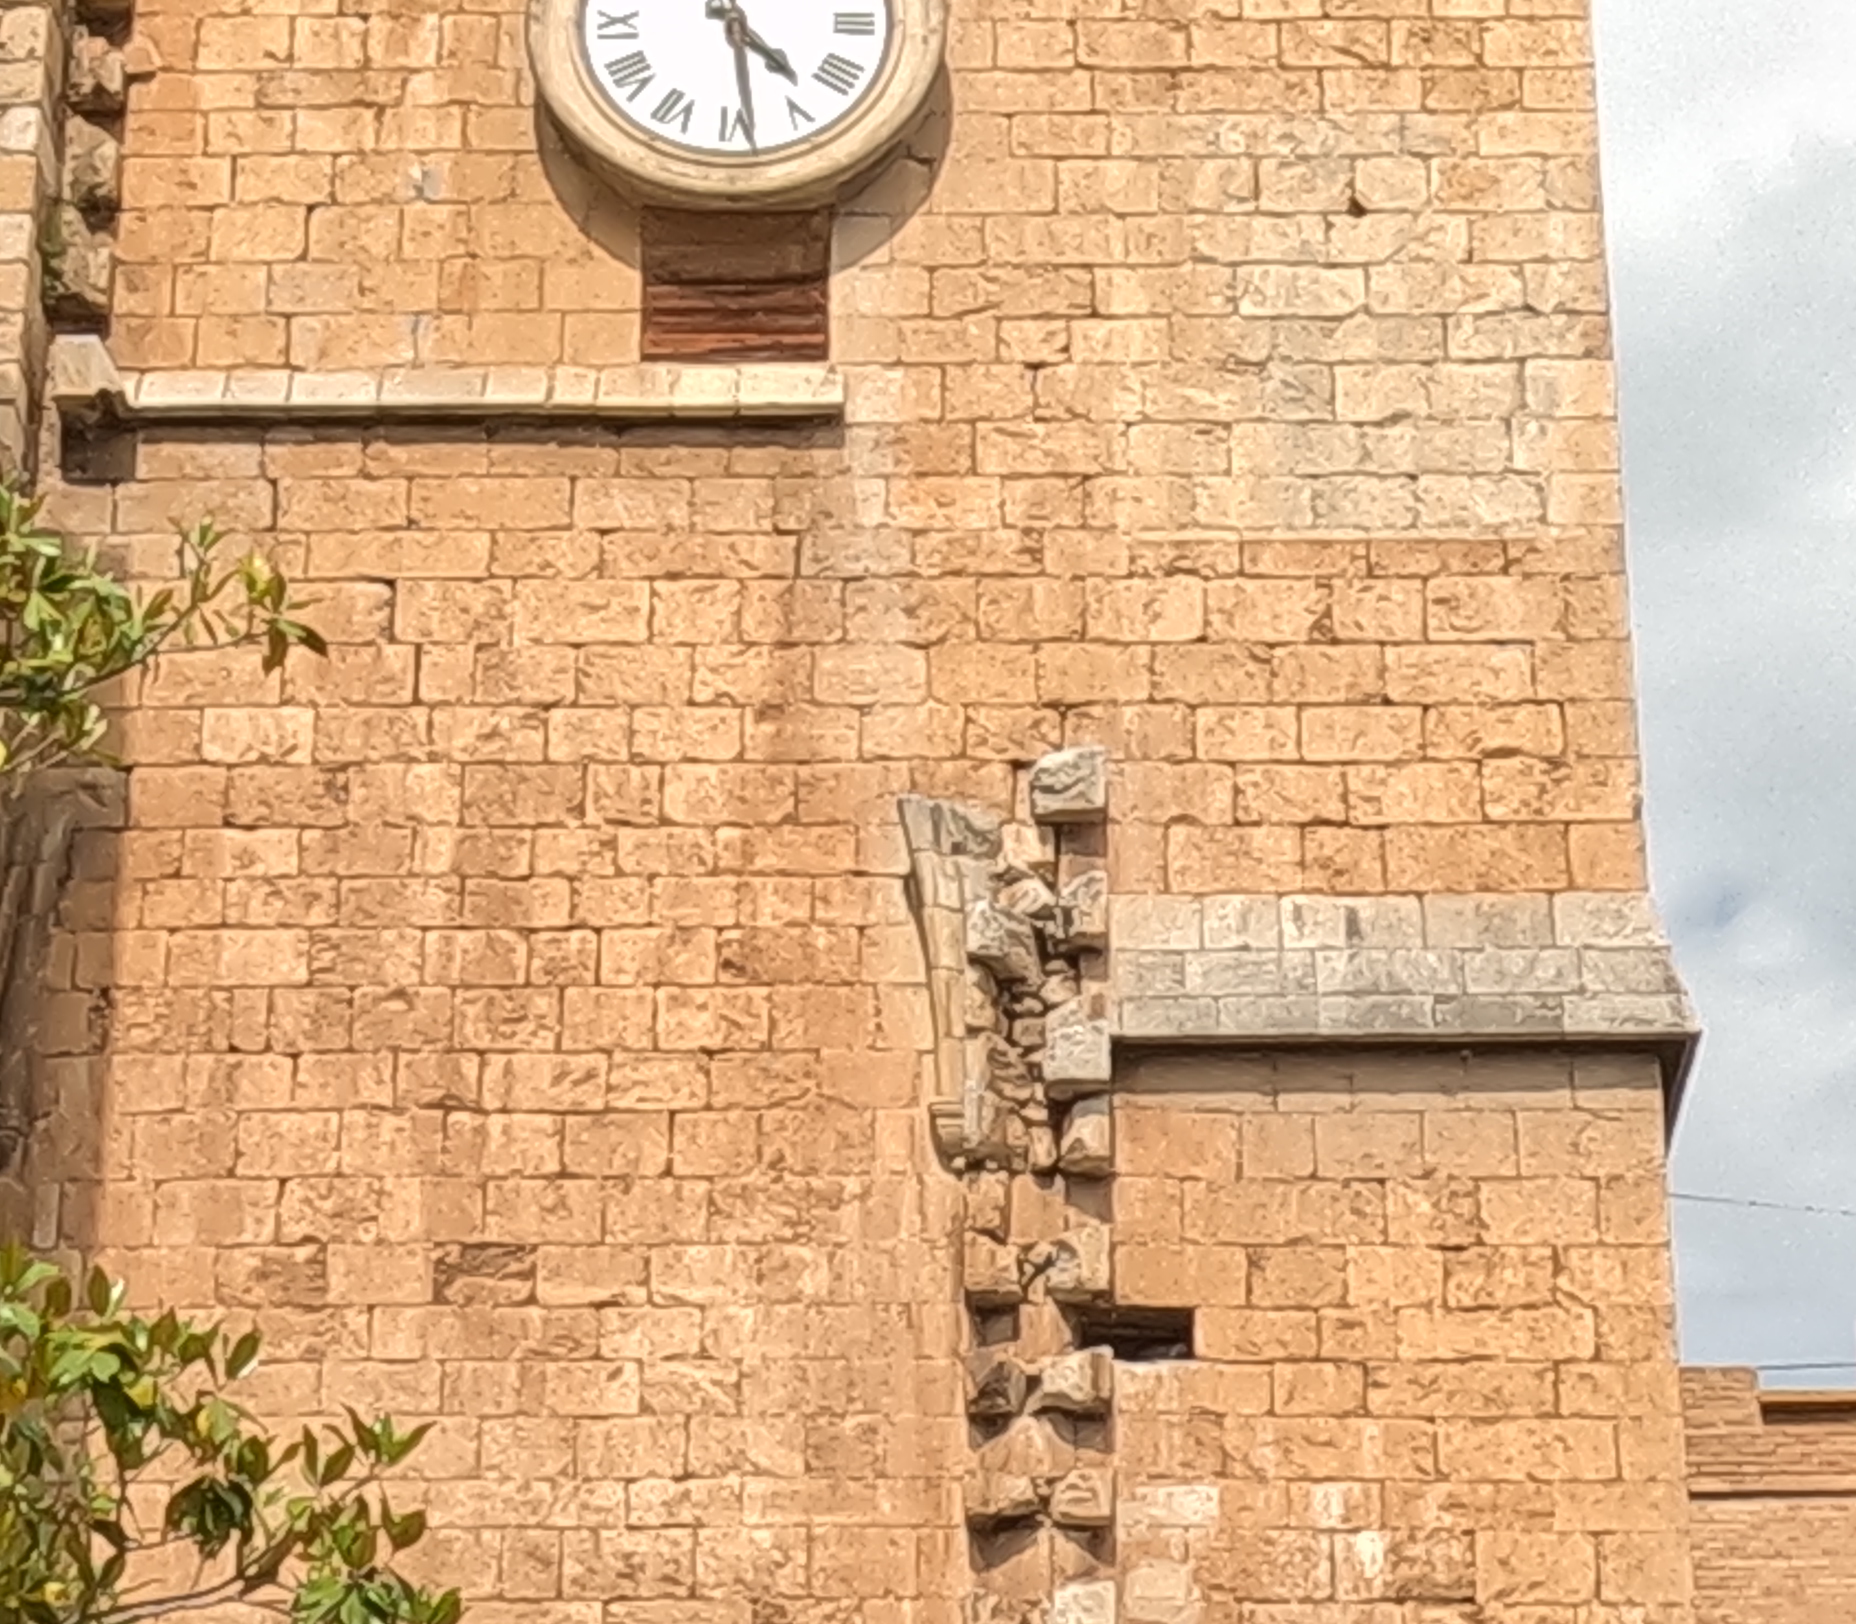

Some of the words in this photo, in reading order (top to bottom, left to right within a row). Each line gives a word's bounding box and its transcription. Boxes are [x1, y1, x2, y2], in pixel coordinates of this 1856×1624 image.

[596, 10, 639, 40] IX
[832, 12, 875, 36] III
[603, 50, 656, 103] VIII
[811, 53, 865, 96] IIII
[650, 87, 695, 134] VII
[718, 105, 757, 143] VI
[785, 94, 816, 131] V
